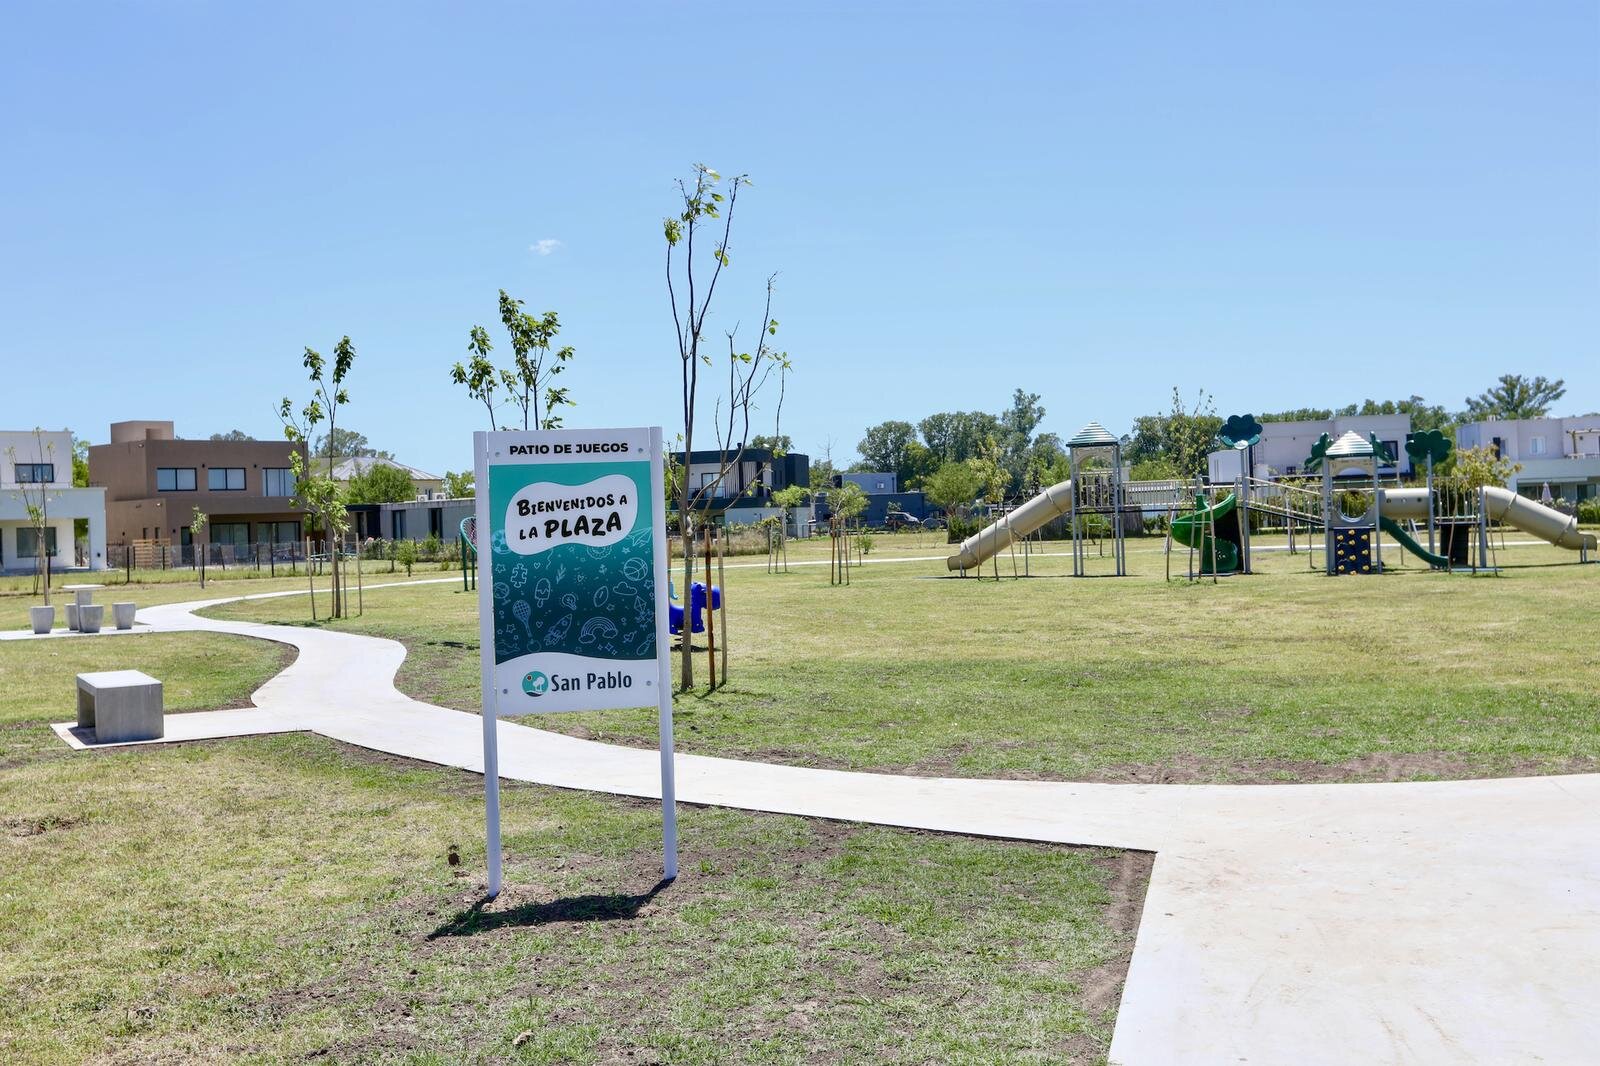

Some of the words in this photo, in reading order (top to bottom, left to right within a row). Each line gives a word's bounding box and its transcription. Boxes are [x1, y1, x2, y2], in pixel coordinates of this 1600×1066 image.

[510, 445, 549, 455] PATIO
[554, 444, 572, 454] DE
[576, 443, 628, 453] JUEGOS
[517, 494, 614, 516] BIENVENIDOS
[620, 495, 627, 505] A
[519, 526, 538, 540] LA
[544, 511, 621, 538] PLAZA
[551, 675, 580, 691] San
[587, 671, 632, 689] Pablo
